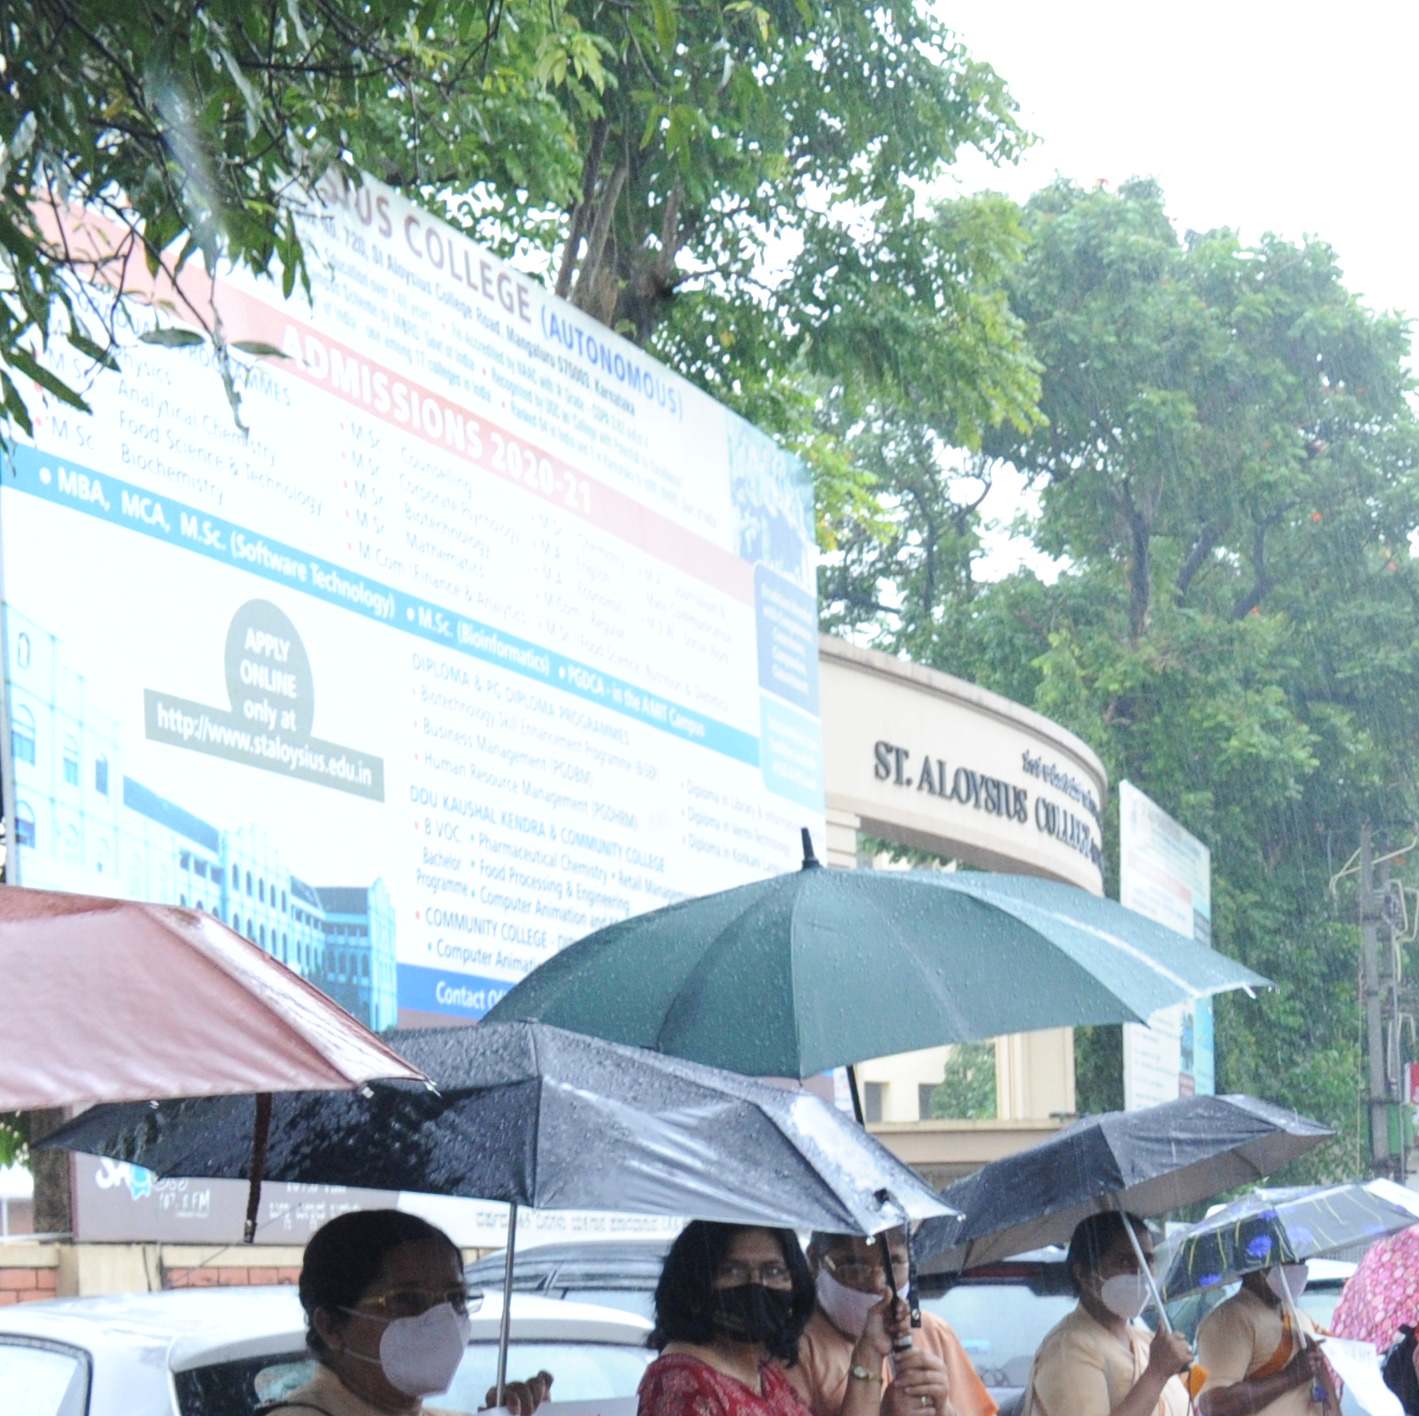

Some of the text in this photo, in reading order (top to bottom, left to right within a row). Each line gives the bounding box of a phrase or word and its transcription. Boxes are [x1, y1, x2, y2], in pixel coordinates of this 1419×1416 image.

[403, 213, 533, 324] COLLEGE
[540, 302, 684, 420] (AUTONOMOUS)
[118, 408, 159, 446] Food
[281, 320, 481, 462] ADMISSIONS
[490, 429, 592, 519] 2020-21
[120, 442, 224, 507] Biochemistry
[57, 464, 395, 624] MBA, MCA, M.Sc. (Software Technology)
[243, 624, 290, 667] APPLY
[417, 603, 450, 637] M.Sc.
[456, 617, 549, 678] (Bioinformatics)
[239, 656, 297, 701] ONLINE
[411, 648, 470, 690] DIPLOMA
[242, 690, 297, 733] only at
[156, 697, 372, 793] http://www.staloysius.edu.in
[422, 713, 474, 751] Business
[475, 732, 546, 778] Management
[422, 747, 466, 779] Human
[469, 761, 519, 795] Resource
[520, 776, 589, 819] Management
[874, 739, 913, 787] ST.
[916, 755, 1028, 824] ALOYSIUS
[442, 790, 496, 826] KAUSHAL
[499, 808, 546, 839] KENDRA
[560, 824, 622, 862] COMMUNITY
[624, 845, 665, 875] COLLEGE
[478, 829, 557, 871] Pharmaceutical
[559, 851, 608, 886] Chemistry
[422, 845, 461, 874] Bachelor
[415, 869, 470, 902] Programme
[478, 884, 533, 919] Computer
[535, 897, 588, 929] Animation
[479, 859, 504, 884] Food
[508, 864, 563, 901] Processing
[575, 882, 630, 920] Engineering
[425, 903, 546, 949] COMMUNITY COLLEGE
[436, 937, 493, 970] Computer
[435, 978, 487, 1012] Contact
[192, 1189, 211, 1209] FM
